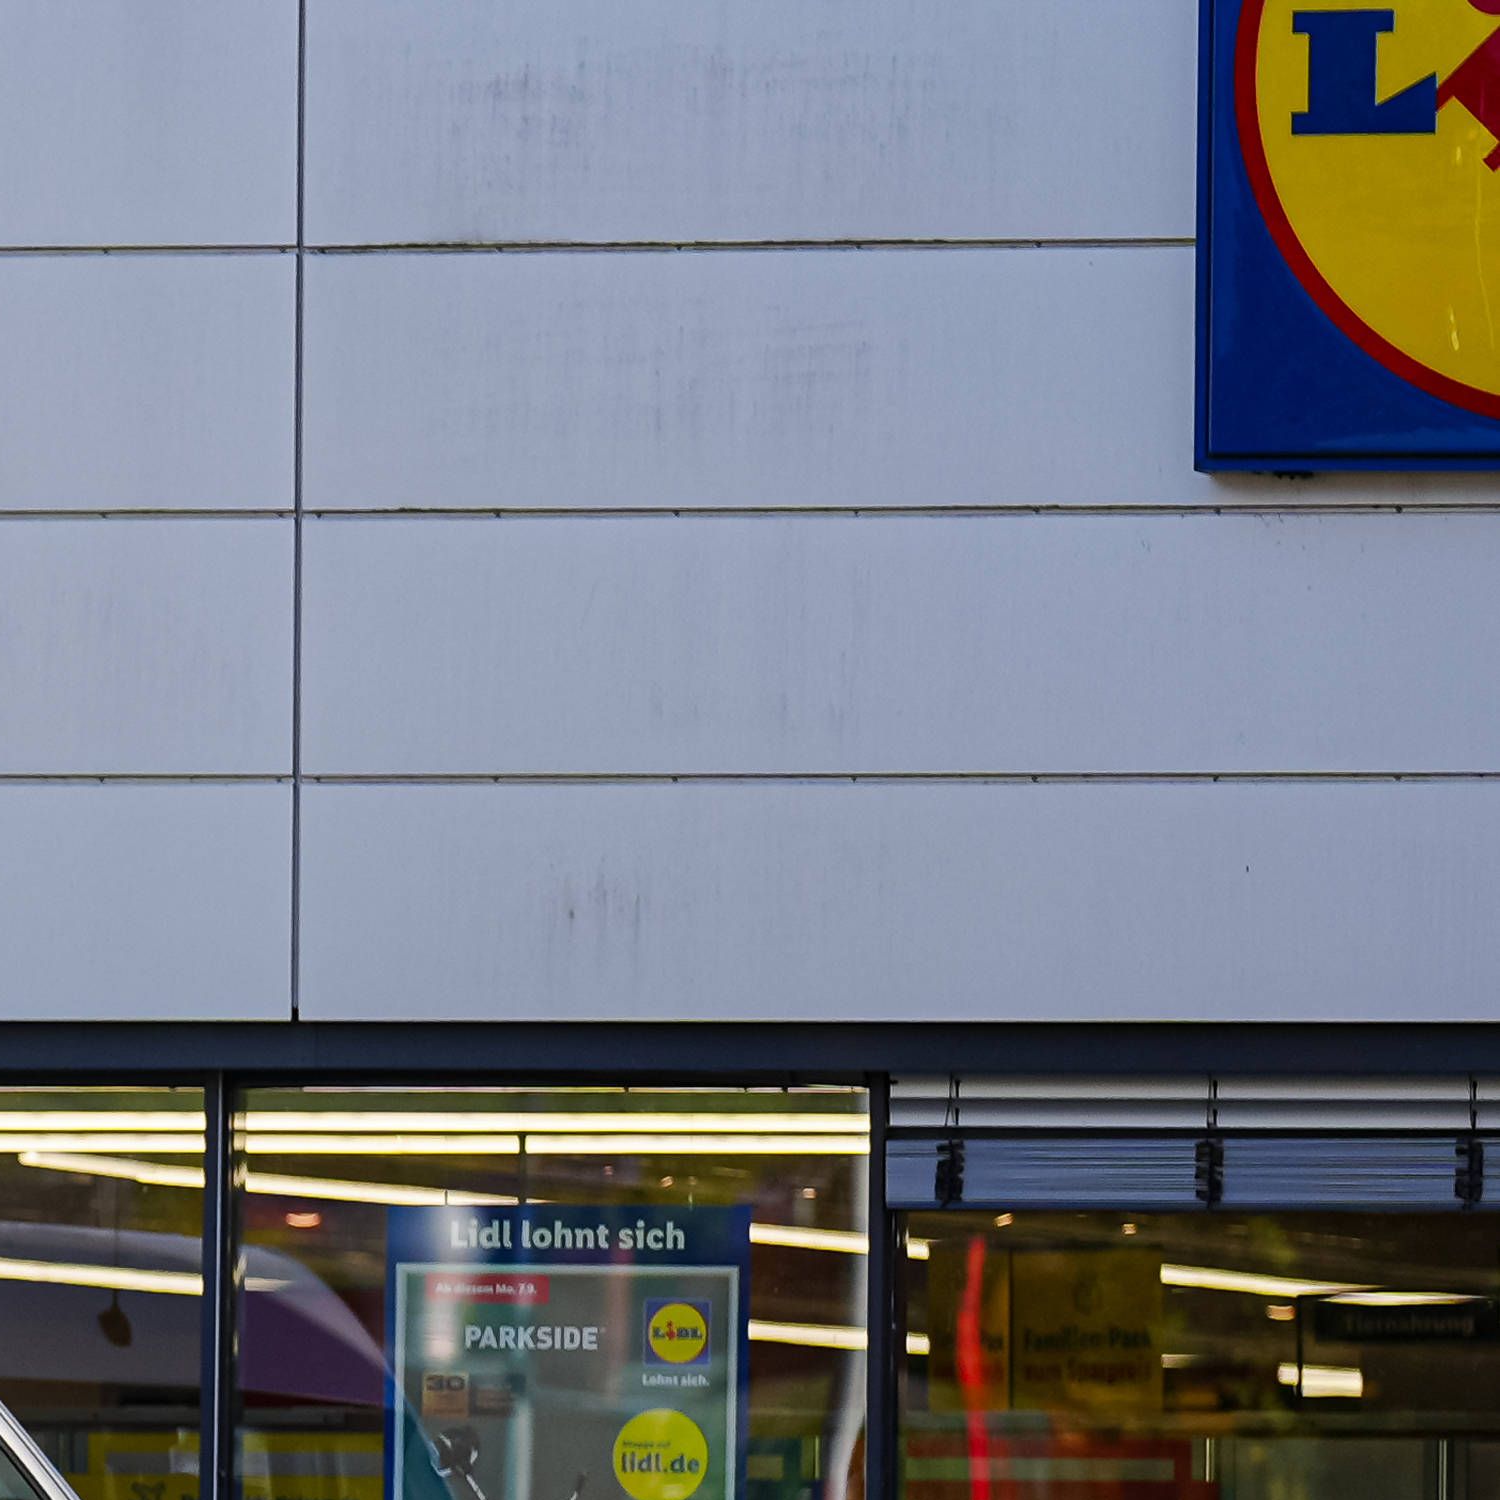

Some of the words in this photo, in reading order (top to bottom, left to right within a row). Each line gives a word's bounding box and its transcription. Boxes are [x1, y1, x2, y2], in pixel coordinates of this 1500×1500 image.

[450, 1219, 511, 1250] Lidl
[521, 1219, 609, 1251] lohnt
[618, 1219, 685, 1251] sich
[465, 1325, 599, 1351] PARKSIDE
[642, 1373, 678, 1387] Lohnt
[680, 1373, 710, 1387] sich.
[621, 1451, 699, 1474] lidl.de
